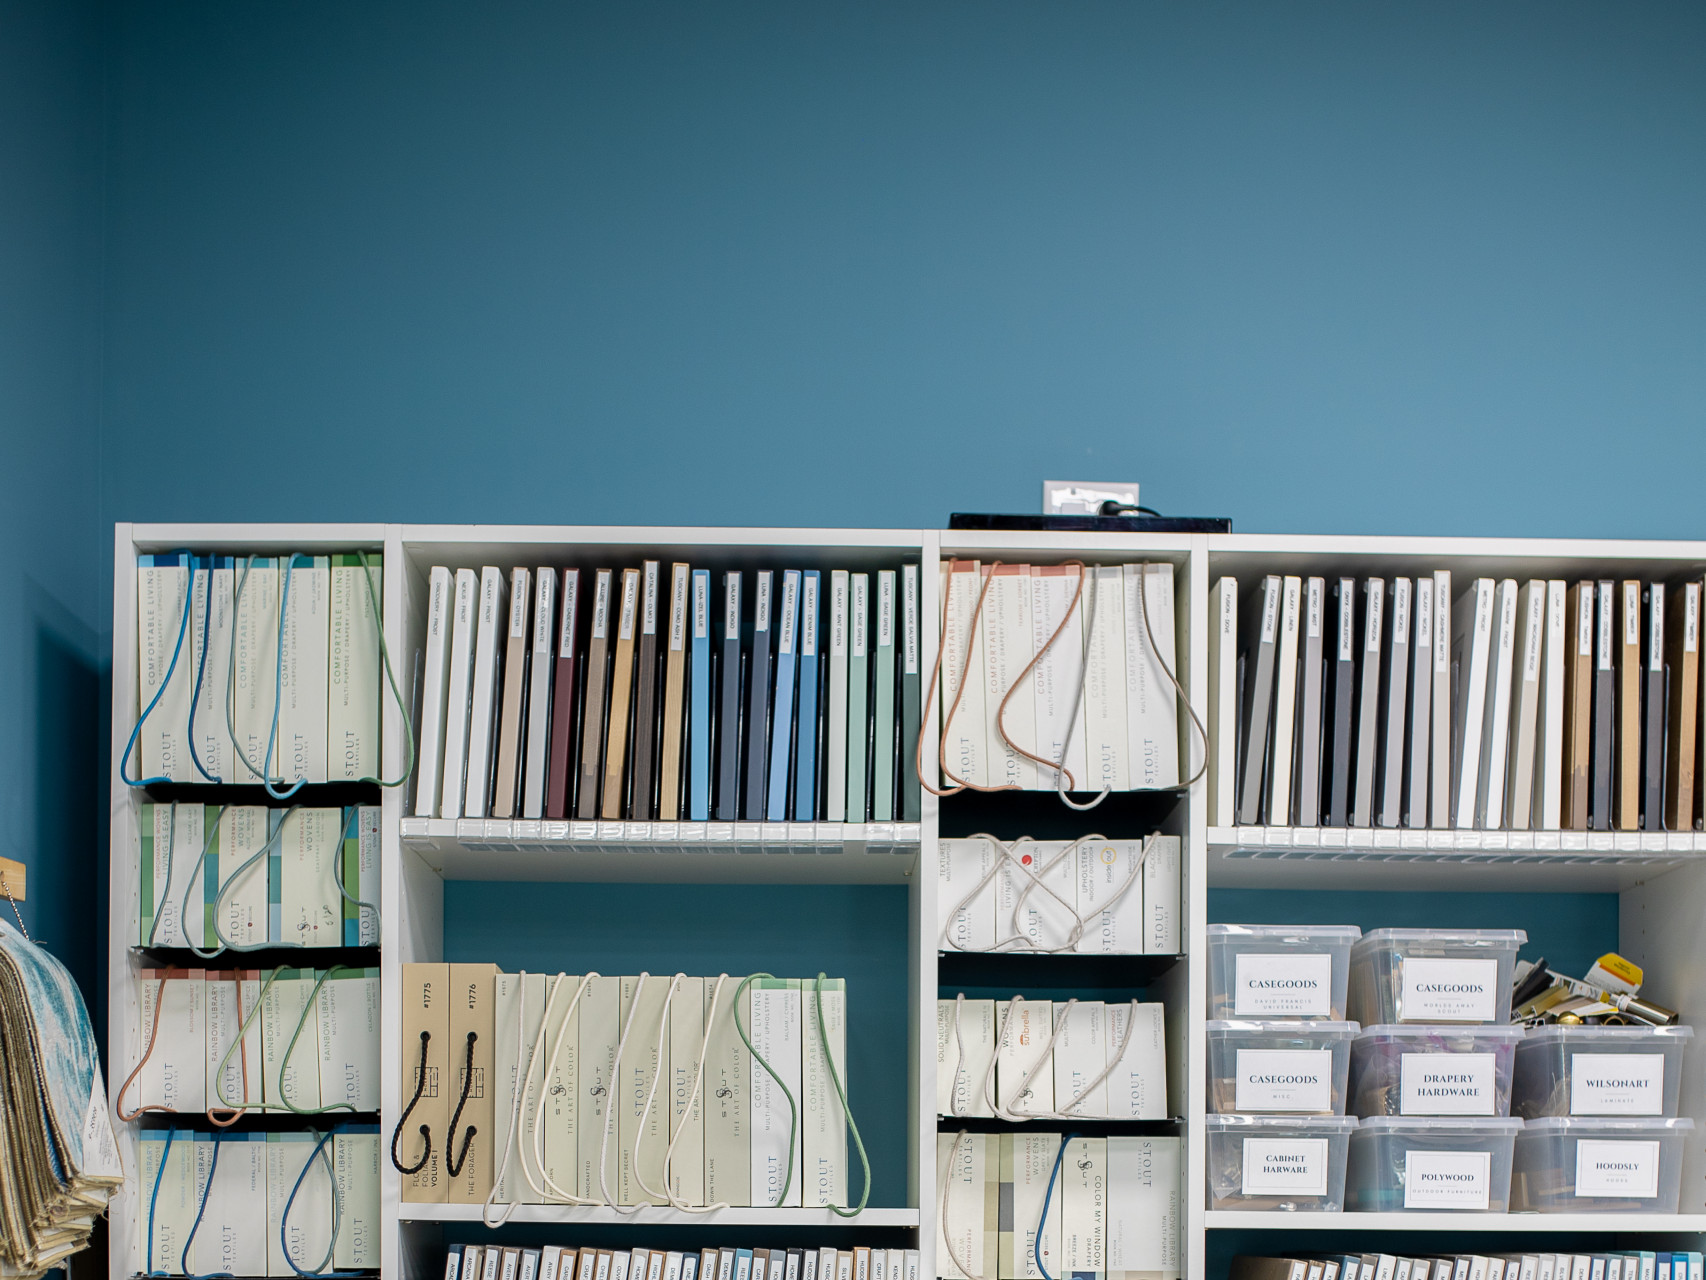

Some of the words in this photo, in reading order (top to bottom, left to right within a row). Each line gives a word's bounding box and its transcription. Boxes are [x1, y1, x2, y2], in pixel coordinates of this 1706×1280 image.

[334, 569, 343, 604] LIVING
[334, 609, 342, 684] COMFORTABLE
[990, 618, 998, 693] COMFORTABLE
[345, 731, 355, 777] STOUT
[1144, 738, 1153, 783] STOUT
[423, 982, 432, 1009] #1775
[468, 983, 477, 1009] #1776
[1248, 979, 1318, 989] CASEGOODS
[1416, 984, 1484, 993] CASEGOODS
[809, 995, 817, 1030] LIVING
[809, 1036, 818, 1112] COMFORTABLE
[1249, 1075, 1318, 1084] CASEGOODS
[1424, 1074, 1474, 1084] DRAPERY
[1586, 1079, 1650, 1088] WILSONART
[634, 1067, 645, 1117] STOUT
[676, 1067, 686, 1115] STOUT
[733, 1084, 740, 1094] OF
[1417, 1088, 1480, 1097] HARDWARE
[468, 1142, 476, 1179] FORAGER
[1263, 1166, 1308, 1174] HARWARE
[1266, 1155, 1306, 1163] CABINET
[1596, 1162, 1640, 1171] HOODSLY
[468, 1180, 476, 1196] THE
[819, 1157, 828, 1203] STOUT
[1421, 1173, 1475, 1182] POLYWOOD
[354, 1218, 363, 1263] STOUT
